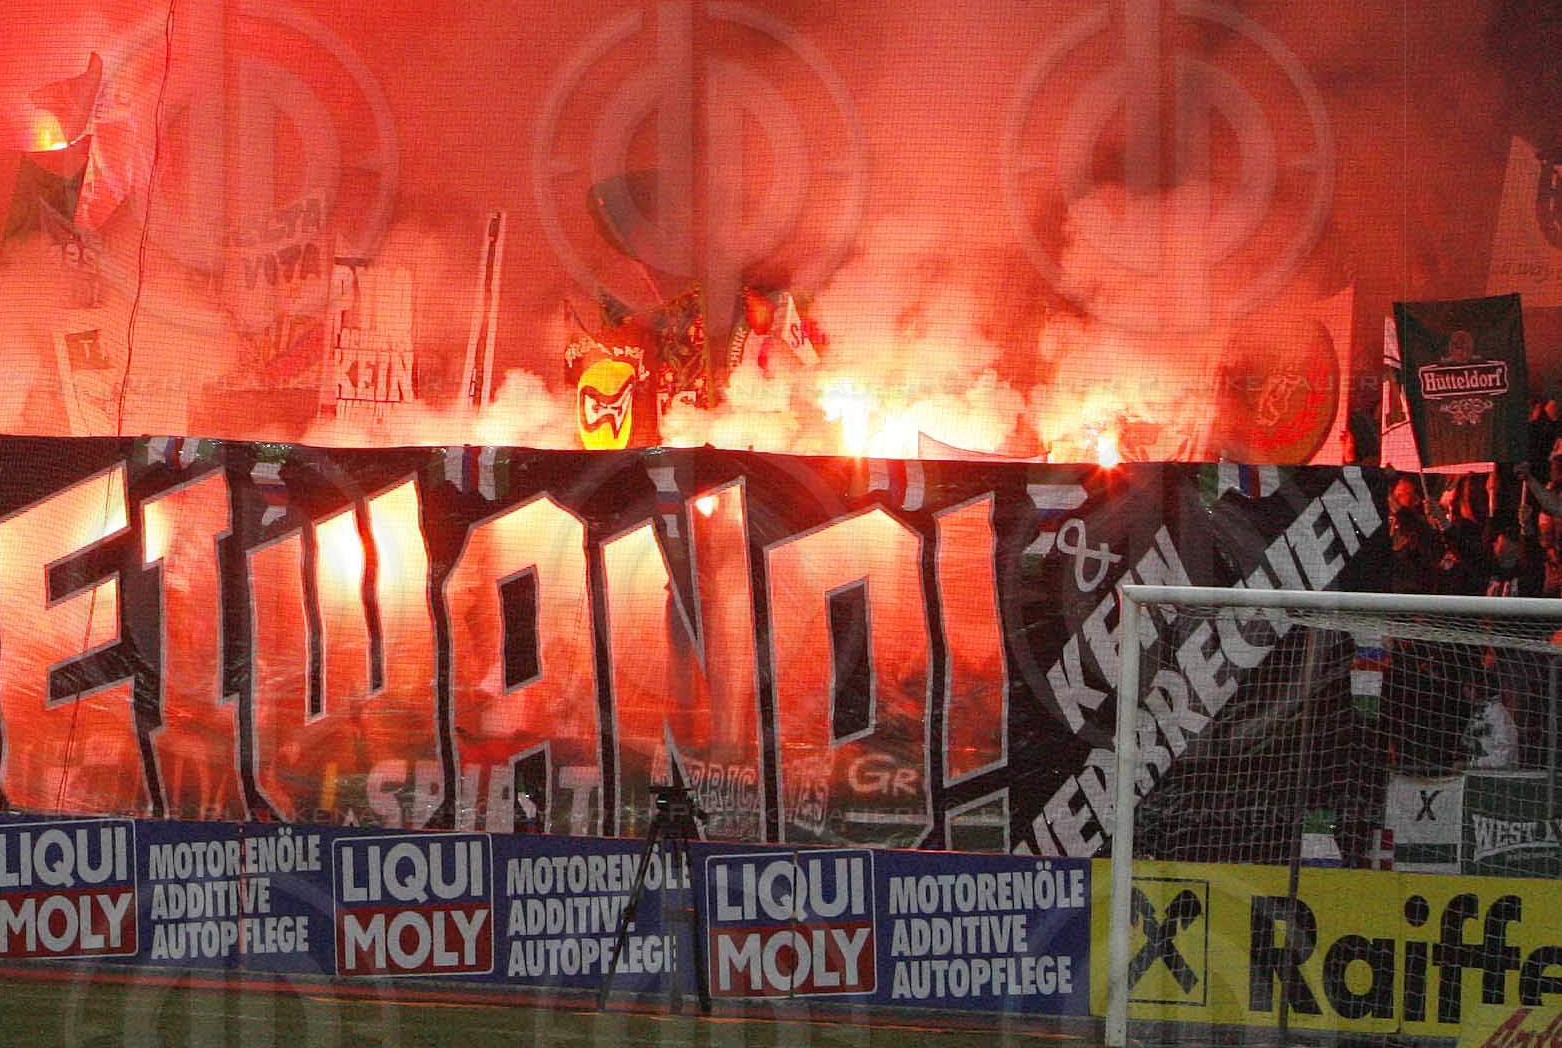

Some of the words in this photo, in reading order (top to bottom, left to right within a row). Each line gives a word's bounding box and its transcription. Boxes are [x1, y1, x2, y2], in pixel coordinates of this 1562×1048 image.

[1056, 518, 1123, 593] &
[149, 826, 322, 881] MOTORENÖLE
[341, 840, 485, 904] LIQUI
[151, 878, 271, 922] ADDITIVE
[716, 857, 866, 922] LIQUI
[889, 863, 1086, 915] MOTORENÖLE
[151, 915, 311, 962] AUTOPFLEGE
[342, 907, 490, 970] MOLY
[717, 927, 871, 992] MOLY
[891, 915, 1028, 957] ADDITIVE
[892, 955, 1073, 1000] AUTOPFLEGE
